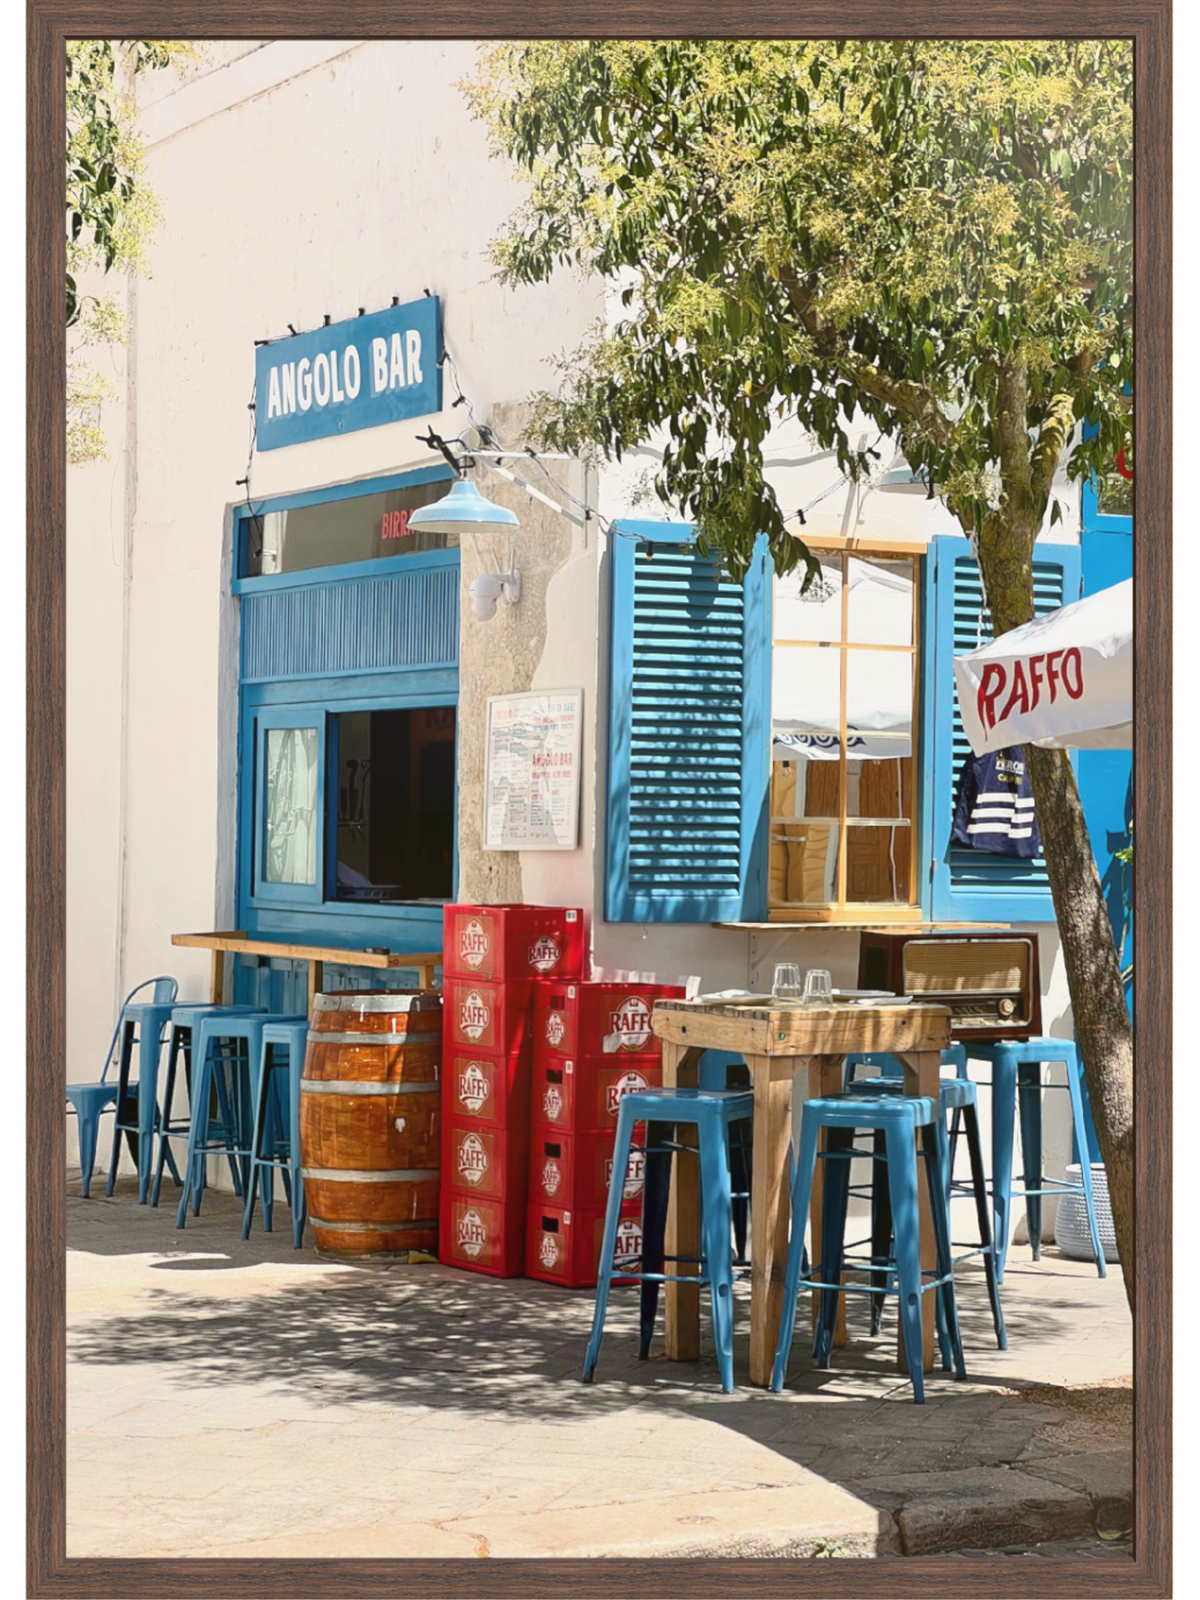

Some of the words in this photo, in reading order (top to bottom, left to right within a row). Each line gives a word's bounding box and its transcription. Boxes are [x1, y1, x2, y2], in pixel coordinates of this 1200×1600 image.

[267, 344, 361, 419] ANGOLO
[372, 328, 423, 392] BAR
[976, 646, 1085, 743] RAFFO
[460, 931, 490, 953] RAFFO
[528, 945, 562, 963] RAFFO
[459, 1003, 490, 1026] RAFFO
[458, 1075, 489, 1099] RAFFO
[457, 1146, 488, 1170] RAFFO
[457, 1220, 488, 1244] RAFFO
[614, 1235, 642, 1255] AFF
